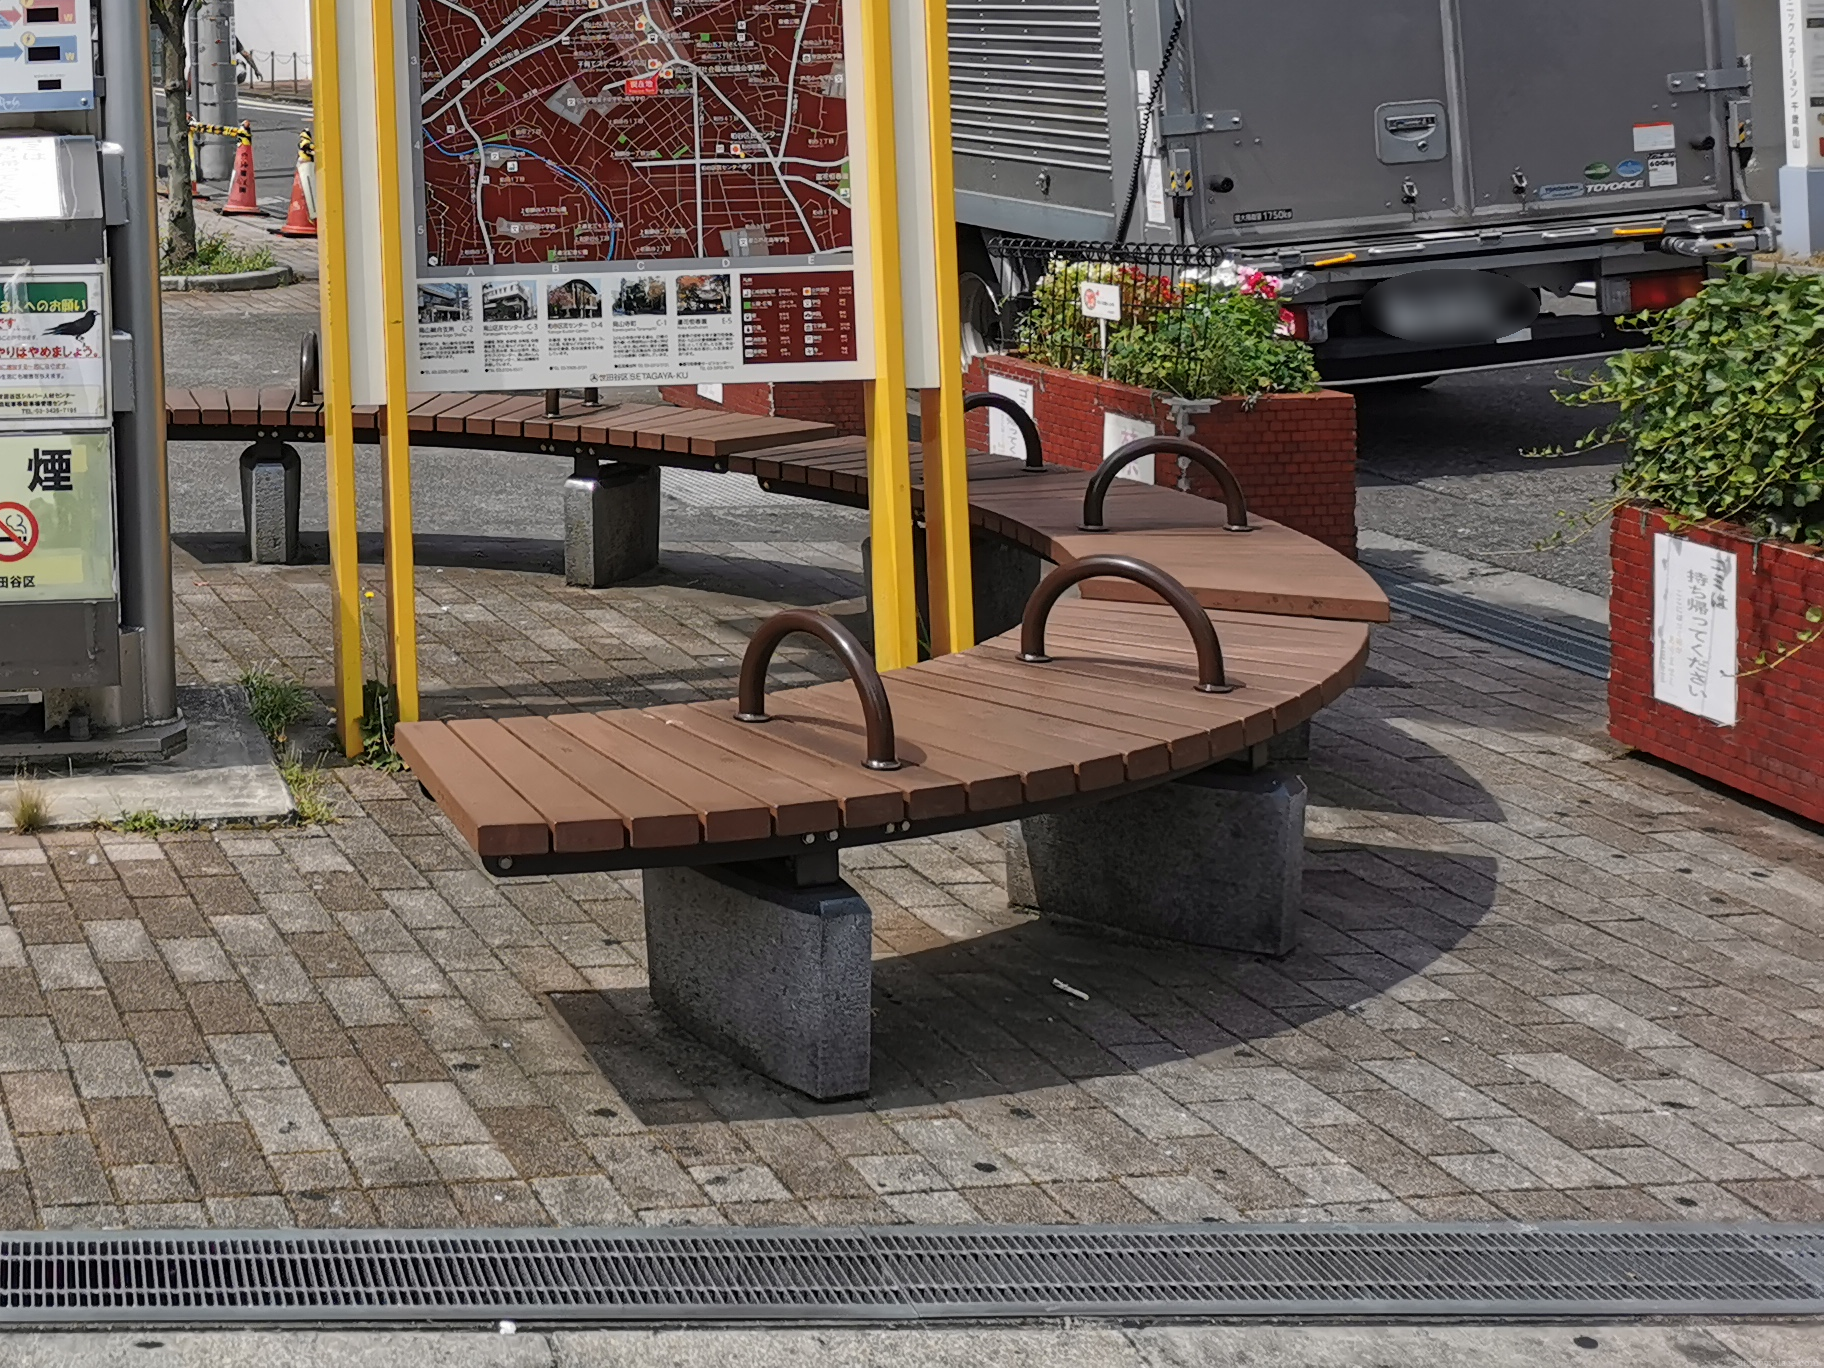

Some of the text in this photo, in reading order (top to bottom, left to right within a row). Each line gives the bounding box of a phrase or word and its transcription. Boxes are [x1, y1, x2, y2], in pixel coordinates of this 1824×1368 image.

[1586, 179, 1645, 193] TOYOACE
[1686, 569, 1709, 699] 持ち帰ってください
